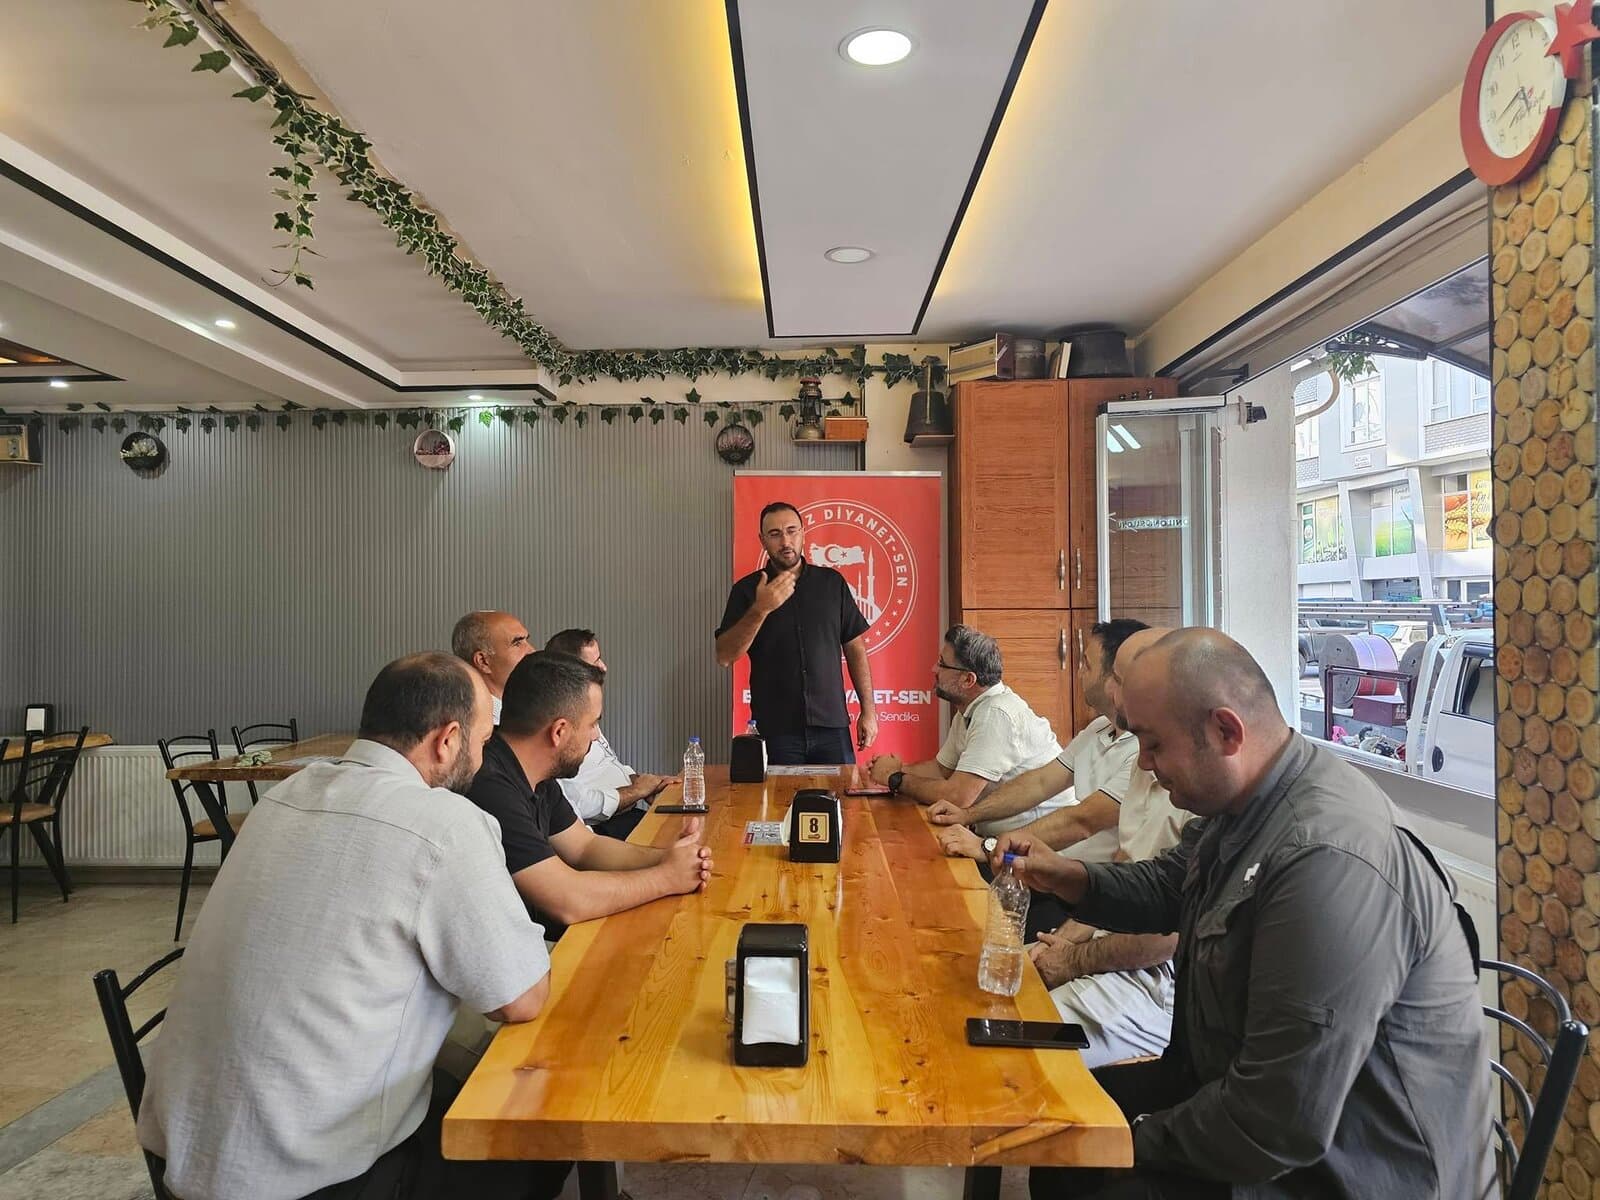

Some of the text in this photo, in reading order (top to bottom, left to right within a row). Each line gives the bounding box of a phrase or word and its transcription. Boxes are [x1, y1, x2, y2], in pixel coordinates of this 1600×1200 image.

[823, 505, 909, 588] DİYANET-SEN
[845, 690, 931, 704] YAET-SEN
[880, 711, 920, 722] Sendika
[809, 817, 819, 833] 8
